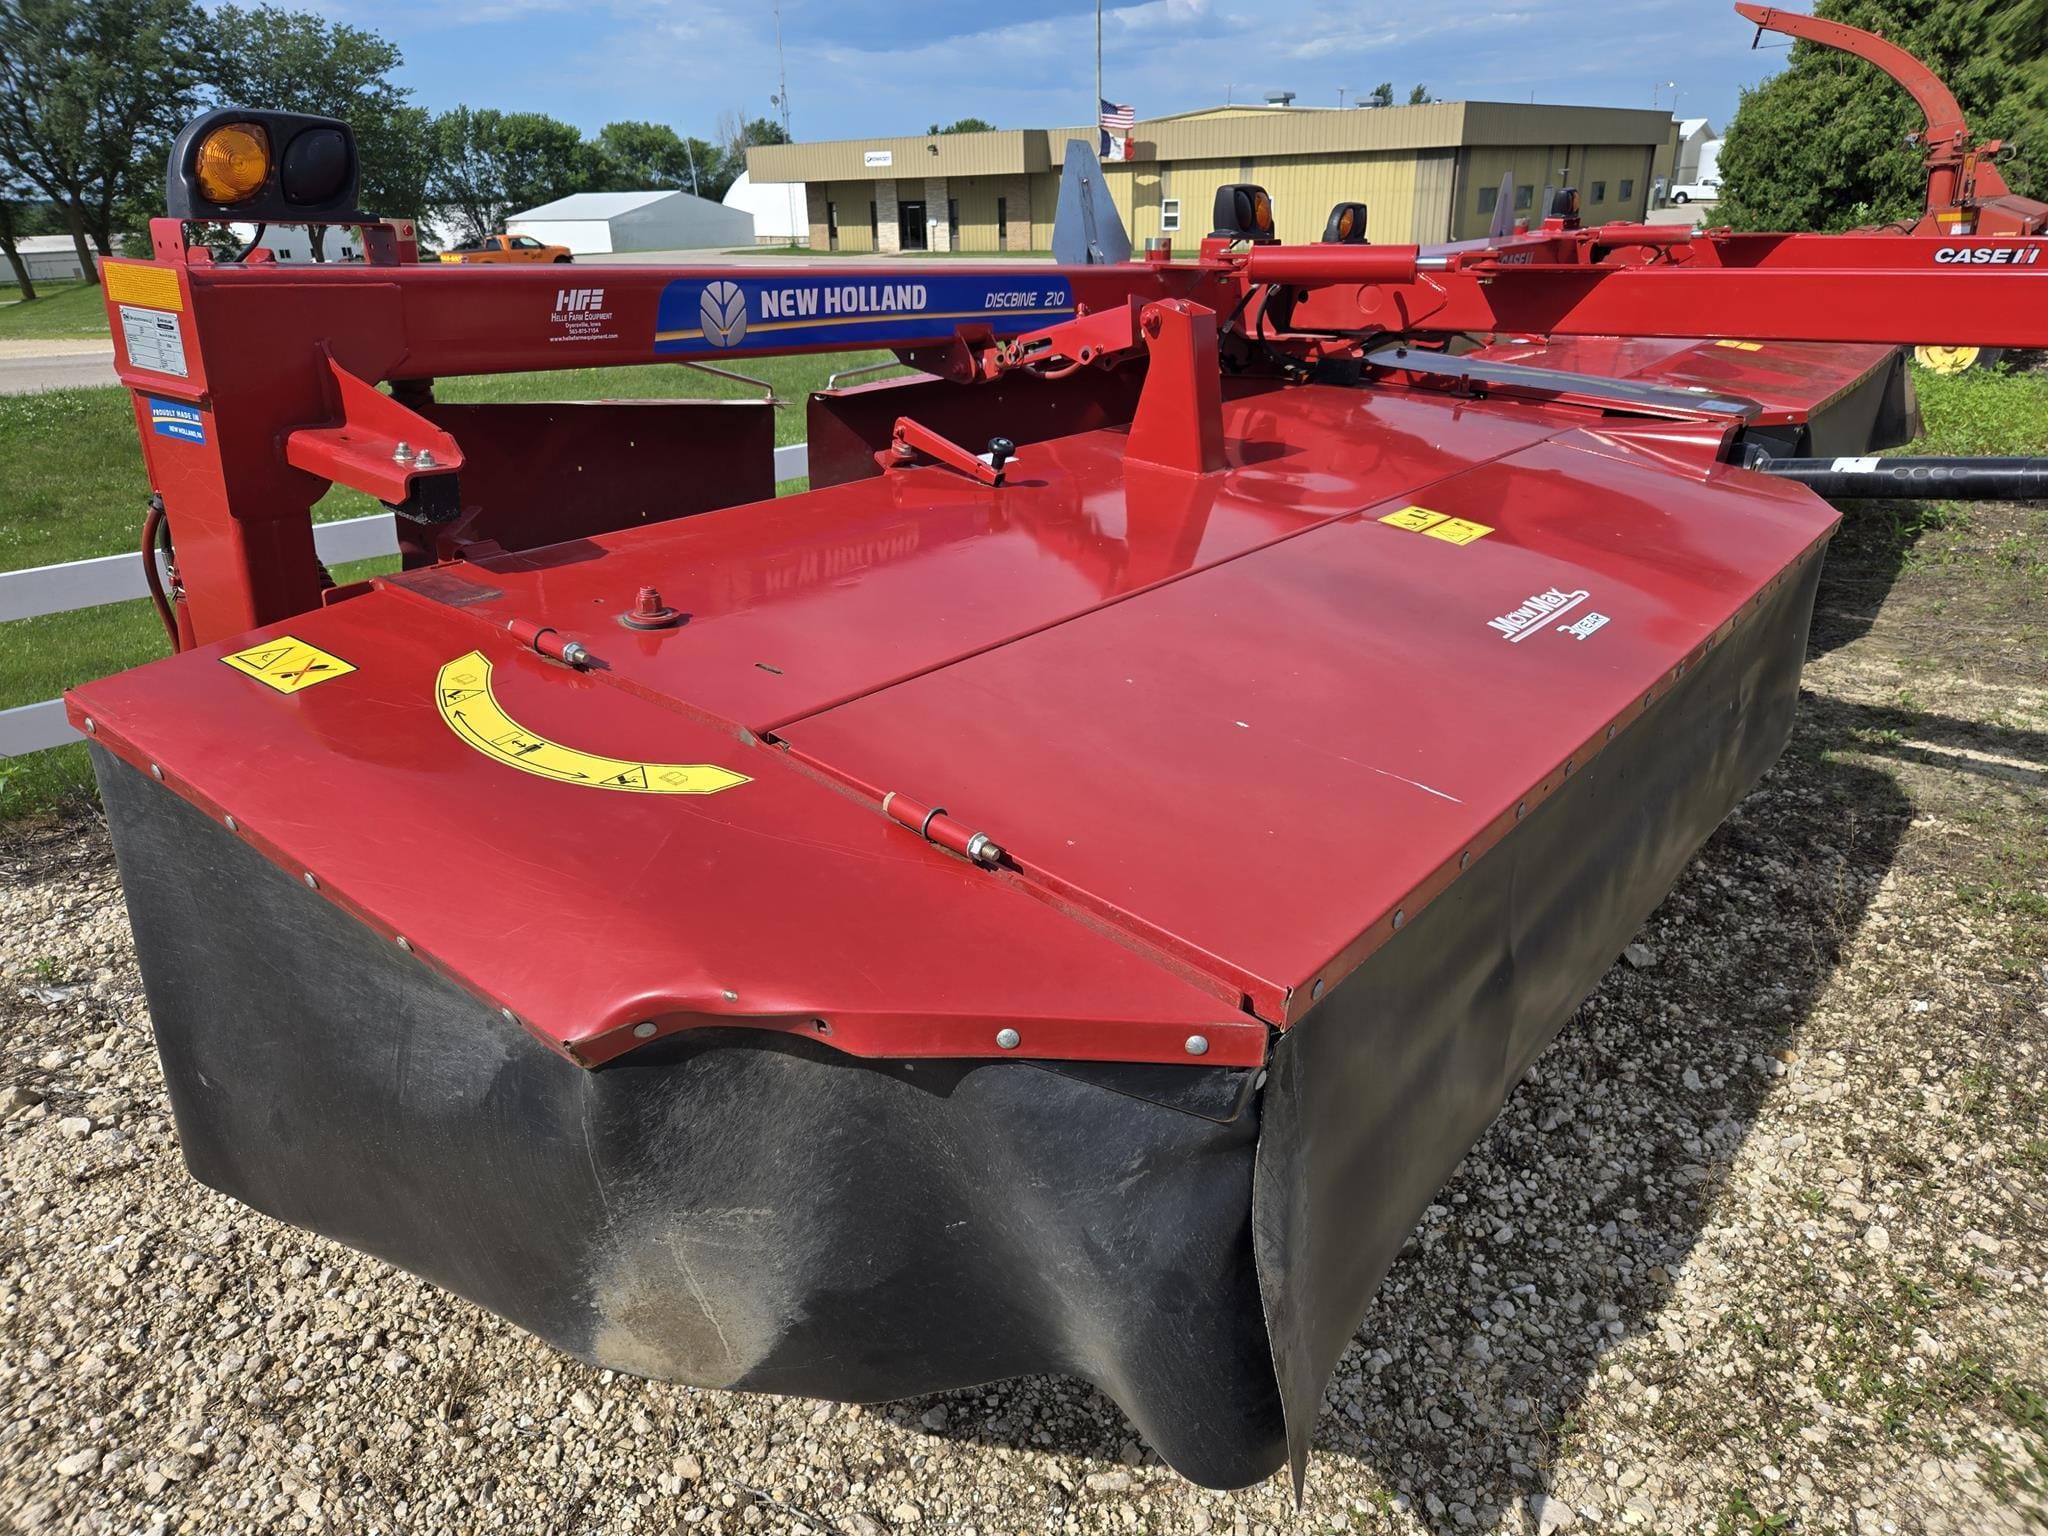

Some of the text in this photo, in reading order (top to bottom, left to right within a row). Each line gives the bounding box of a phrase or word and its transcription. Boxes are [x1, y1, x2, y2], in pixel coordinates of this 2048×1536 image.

[1935, 248, 2011, 264] CASE
[556, 289, 604, 311] HFE
[761, 285, 927, 318] NEW HOLLAND
[985, 291, 1065, 308] DISCBINE 210
[569, 311, 583, 321] FARM
[585, 311, 613, 320] EQUIPMENT
[153, 409, 200, 421] PROUDLY MADE IN
[169, 425, 179, 433] NEW
